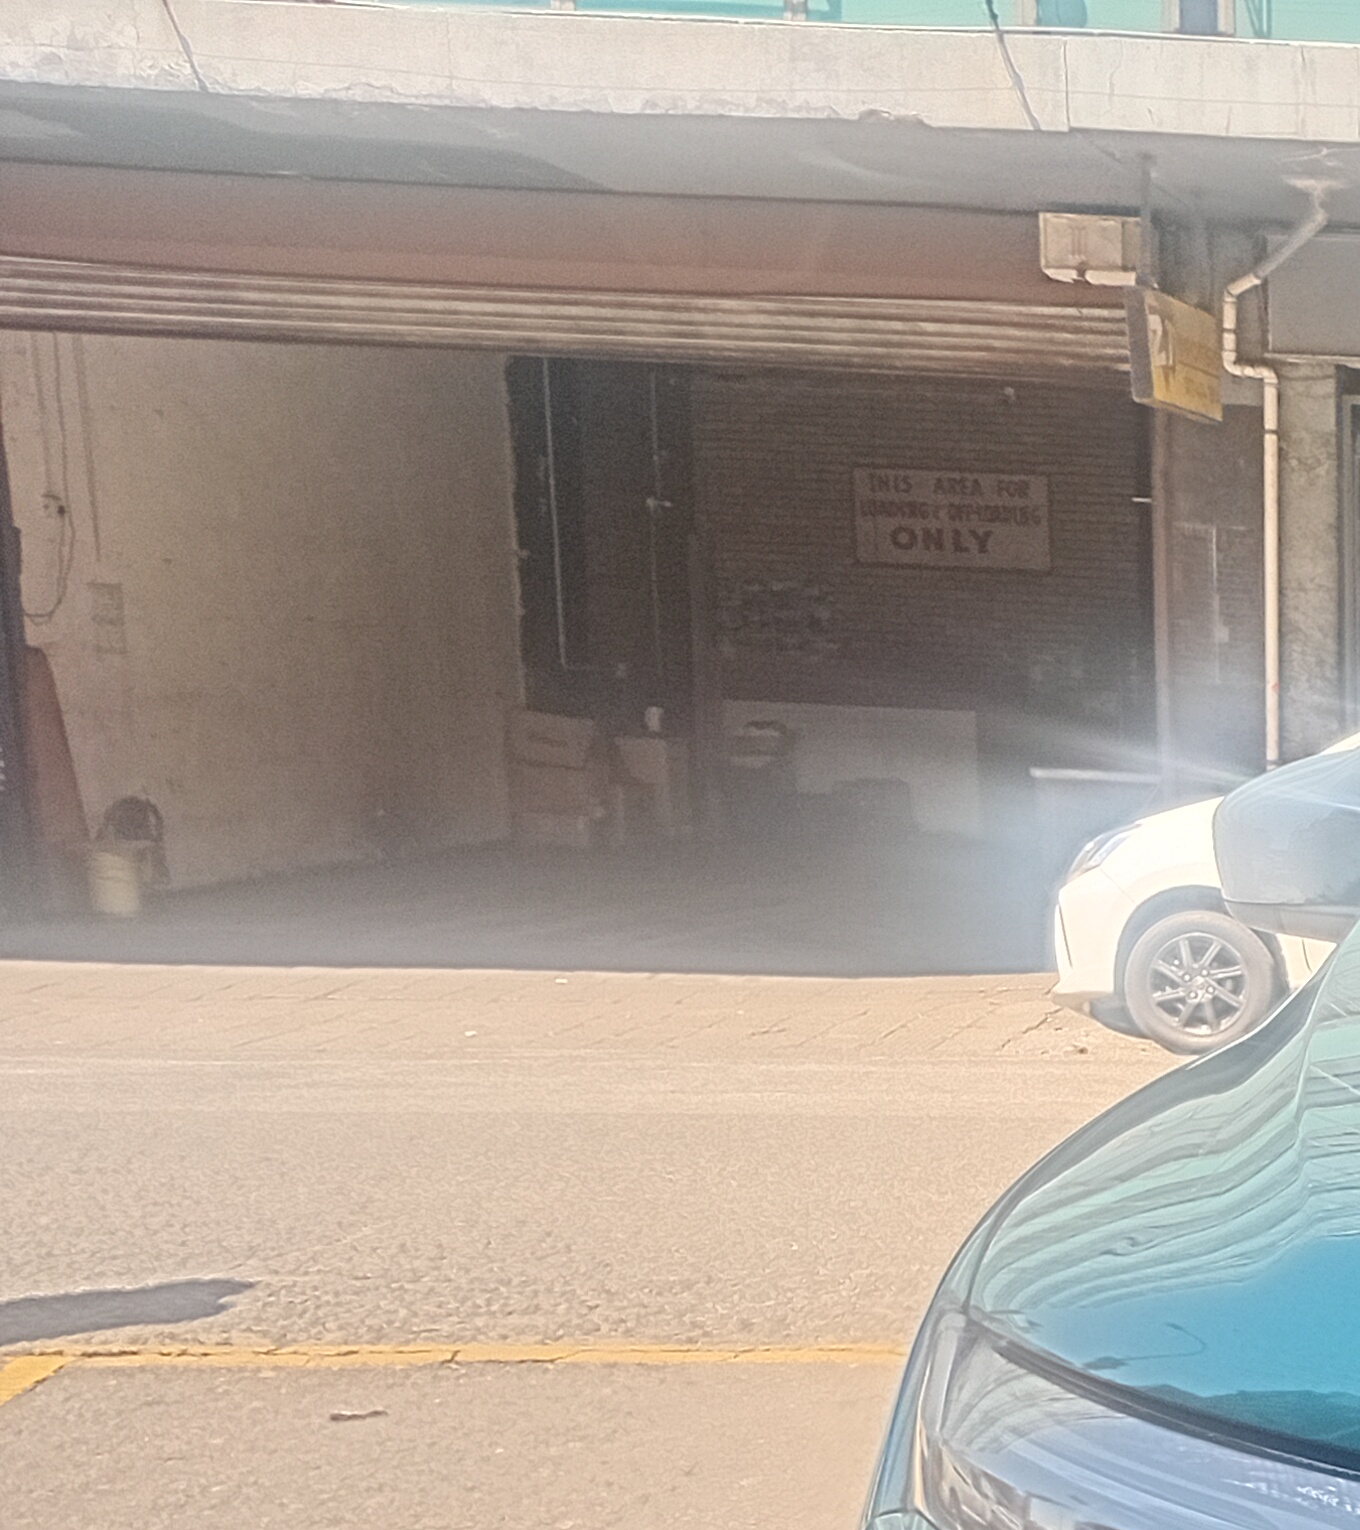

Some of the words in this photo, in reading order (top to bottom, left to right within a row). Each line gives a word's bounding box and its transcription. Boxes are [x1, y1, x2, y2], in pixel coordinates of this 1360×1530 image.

[869, 473, 914, 494] THIS
[932, 476, 984, 497] AREA
[997, 479, 1031, 498] FOR
[890, 525, 994, 555] ONLY
